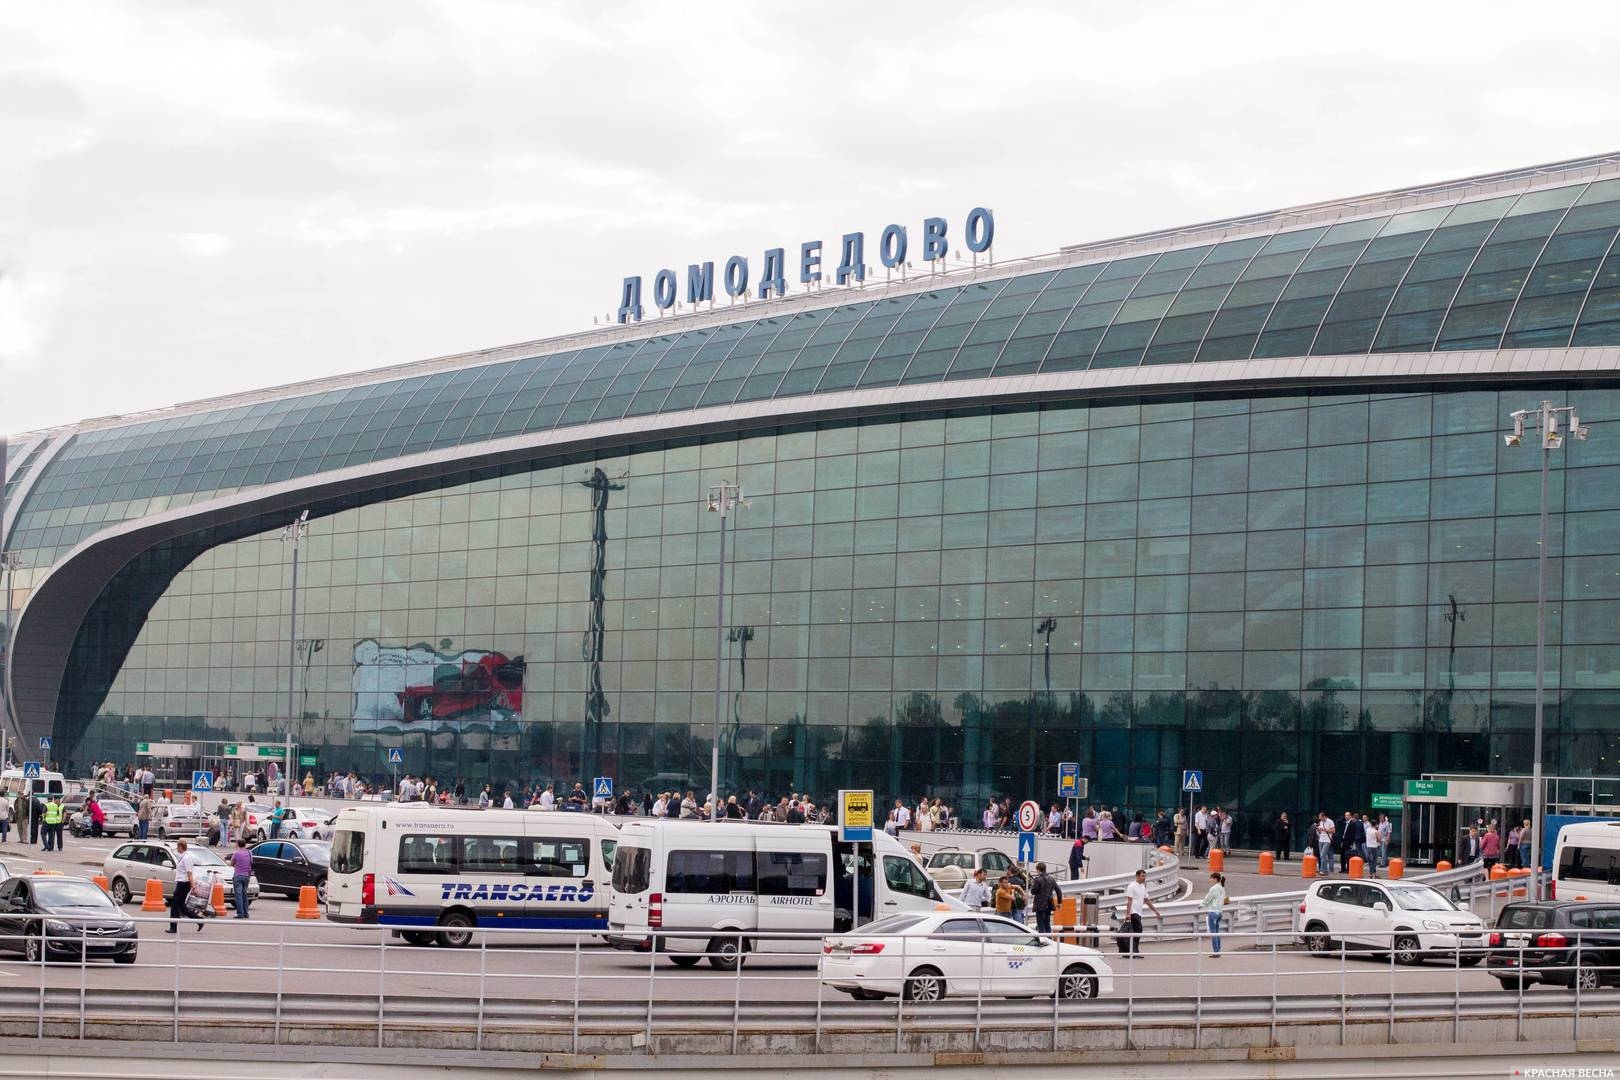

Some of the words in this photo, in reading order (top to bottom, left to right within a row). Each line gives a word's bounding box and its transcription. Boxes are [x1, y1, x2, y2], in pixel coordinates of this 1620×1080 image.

[618, 206, 994, 323] ДОМОДЕДОВО
[1025, 810, 1030, 821] 5
[441, 883, 595, 902] TRANSAERO
[708, 895, 756, 904] АЭРОТЕЛЬ
[770, 896, 814, 905] AIRHOTEL
